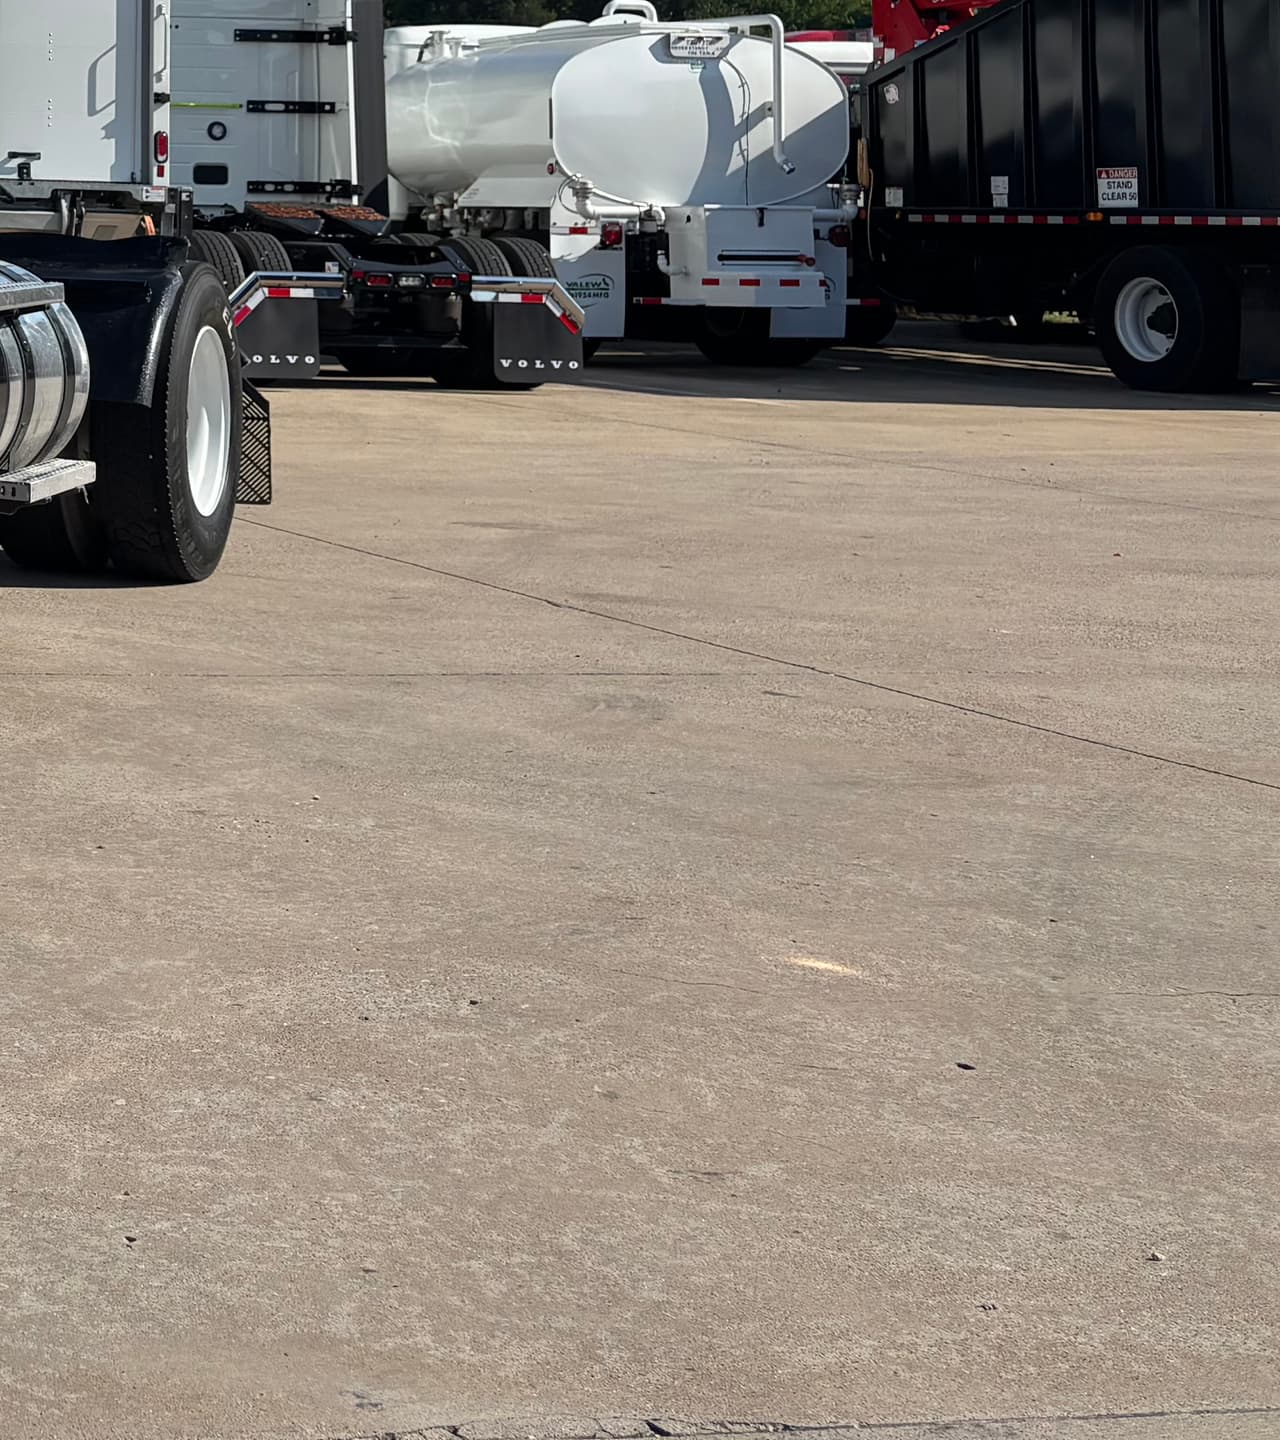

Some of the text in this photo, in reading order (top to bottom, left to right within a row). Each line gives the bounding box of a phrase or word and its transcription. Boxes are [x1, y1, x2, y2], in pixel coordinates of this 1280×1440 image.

[1106, 181, 1133, 190] STAND
[1101, 191, 1127, 201] CLEAR
[251, 354, 316, 364] OLVO
[499, 358, 579, 369] VOLVO
